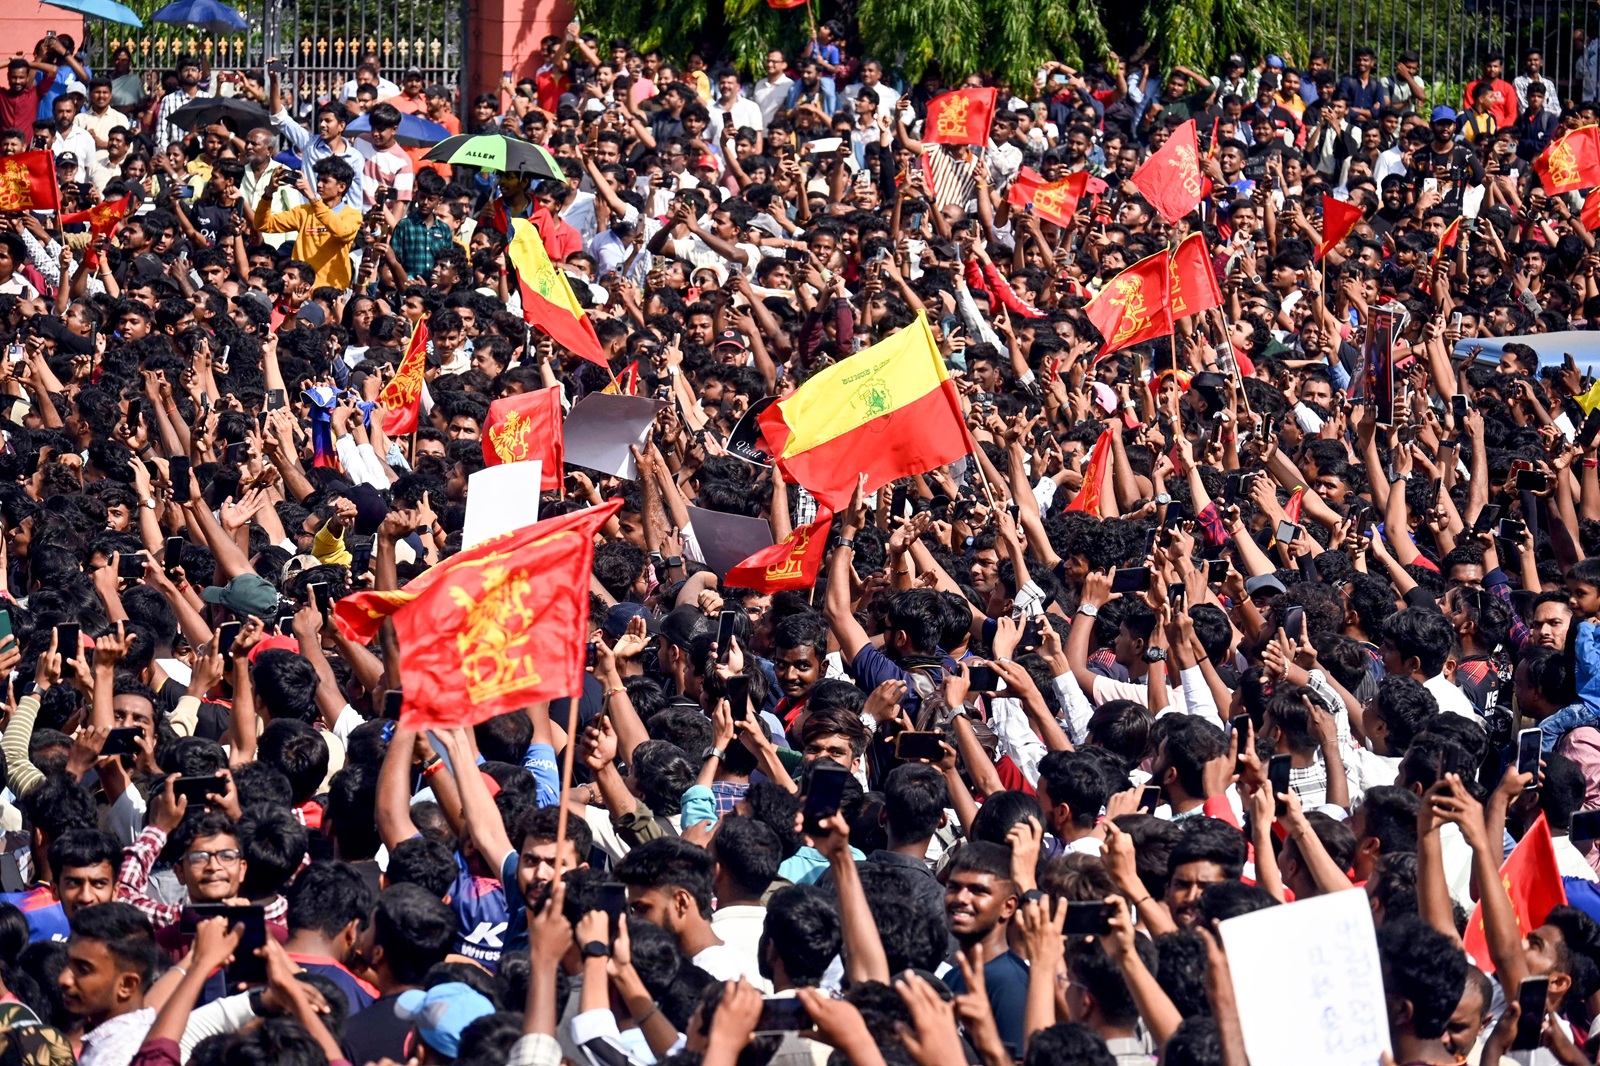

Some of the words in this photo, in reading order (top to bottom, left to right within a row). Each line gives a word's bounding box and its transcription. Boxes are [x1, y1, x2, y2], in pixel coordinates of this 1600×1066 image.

[465, 150, 496, 160] ALLEN
[735, 440, 762, 458] Virat
[461, 943, 501, 961] Wires
